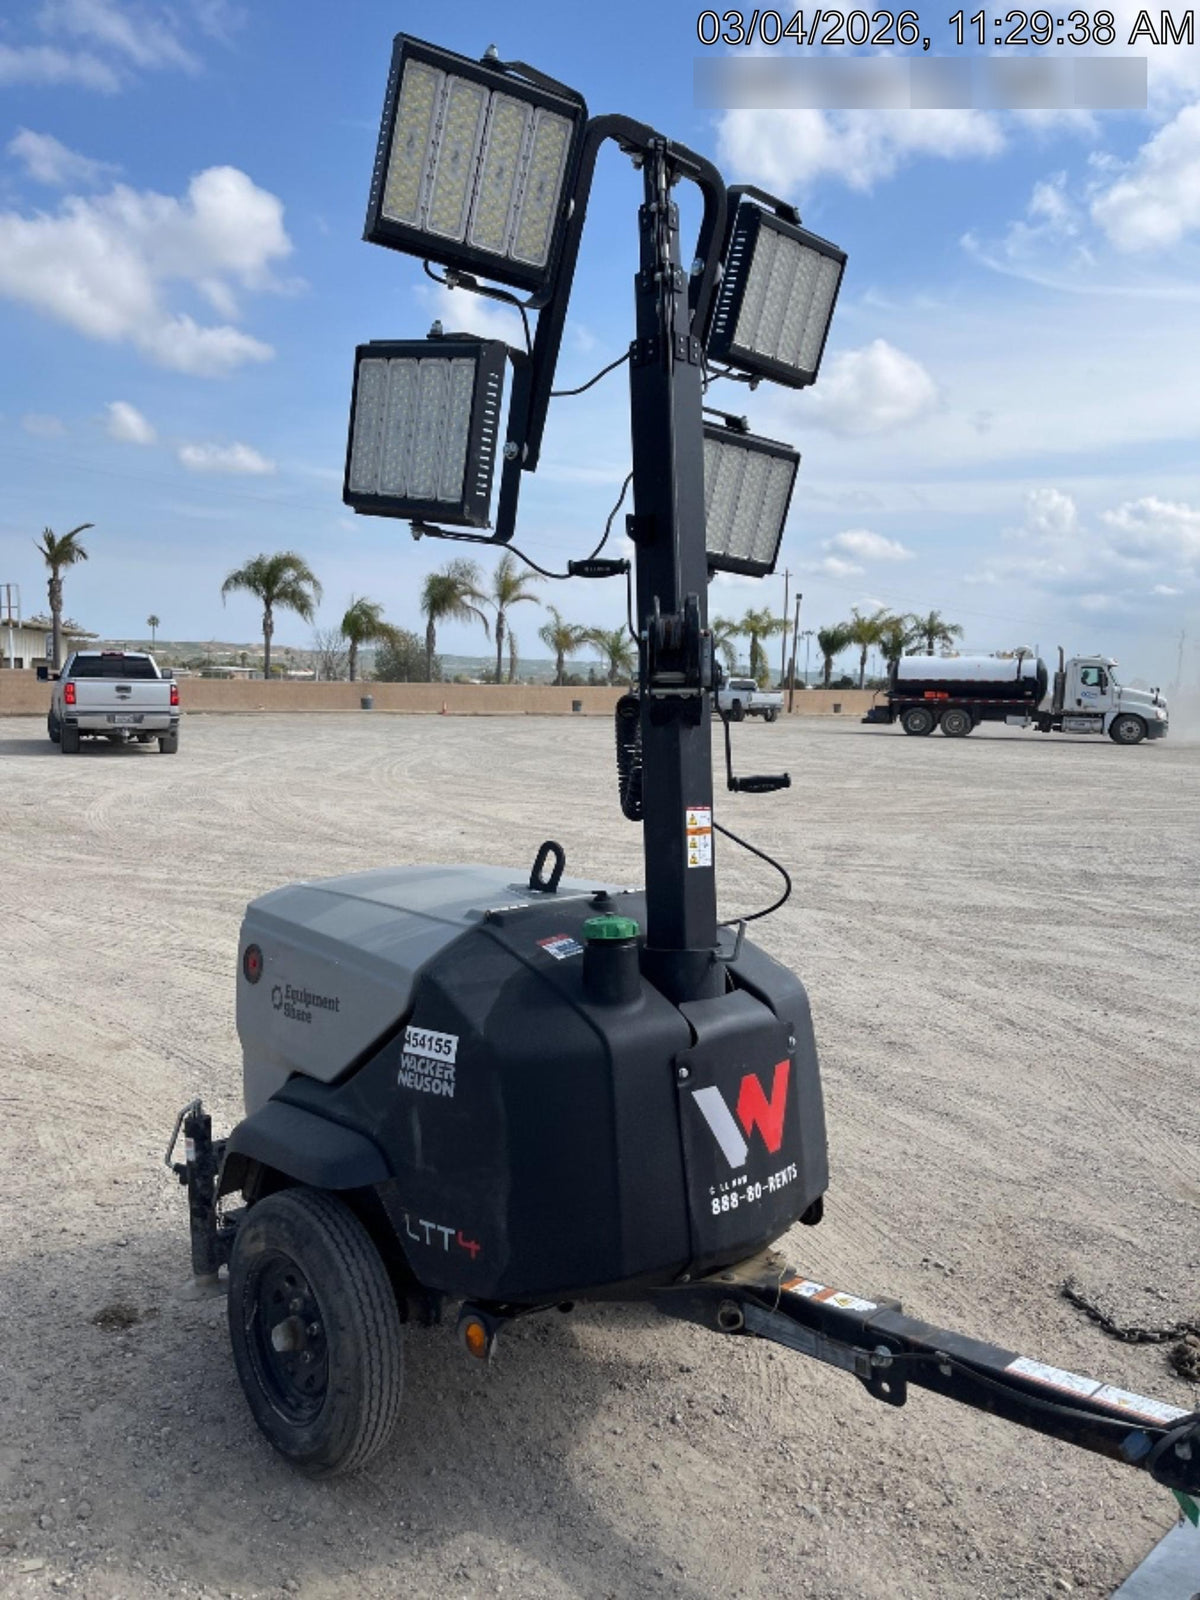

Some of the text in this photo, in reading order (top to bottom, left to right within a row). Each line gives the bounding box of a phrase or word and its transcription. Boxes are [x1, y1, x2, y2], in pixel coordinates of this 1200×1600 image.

[401, 1053, 456, 1081] WACKER
[397, 1069, 456, 1098] NEUSON
[404, 1213, 481, 1259] LTT4
